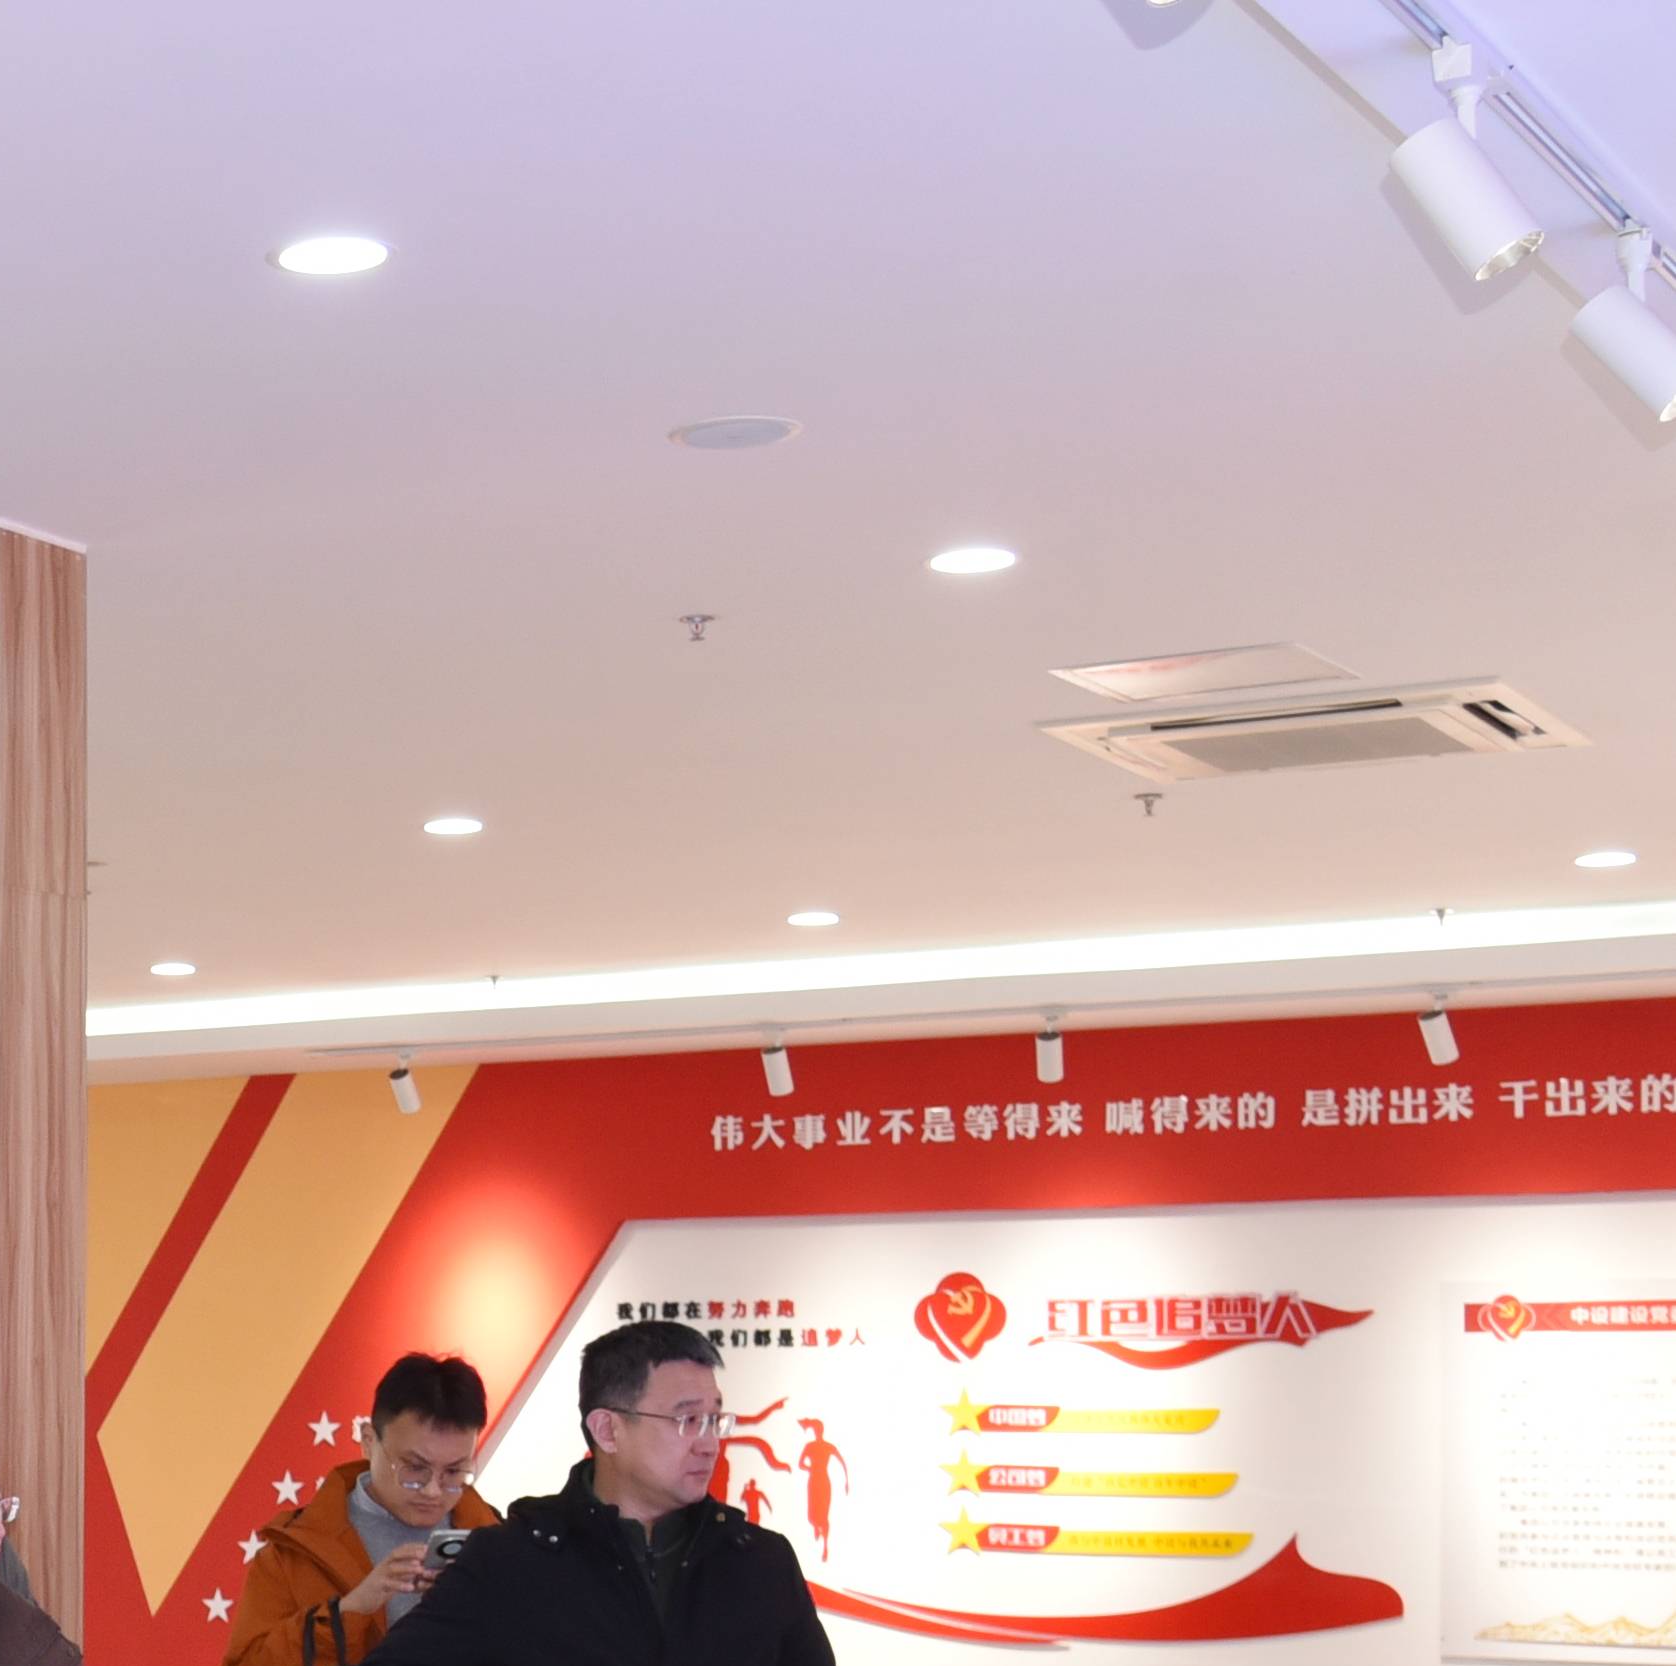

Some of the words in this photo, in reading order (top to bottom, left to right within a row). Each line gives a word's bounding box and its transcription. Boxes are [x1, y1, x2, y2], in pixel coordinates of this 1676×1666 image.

[710, 1101, 1084, 1151] 伟大事业不是等得来
[1105, 1093, 1275, 1137] 喊得来的
[1301, 1082, 1474, 1128] 是拼出来
[1498, 1074, 1676, 1119] 干出来的
[616, 1299, 796, 1321] 我们都在努力奔跑
[1569, 1304, 1676, 1326] 中设建设党
